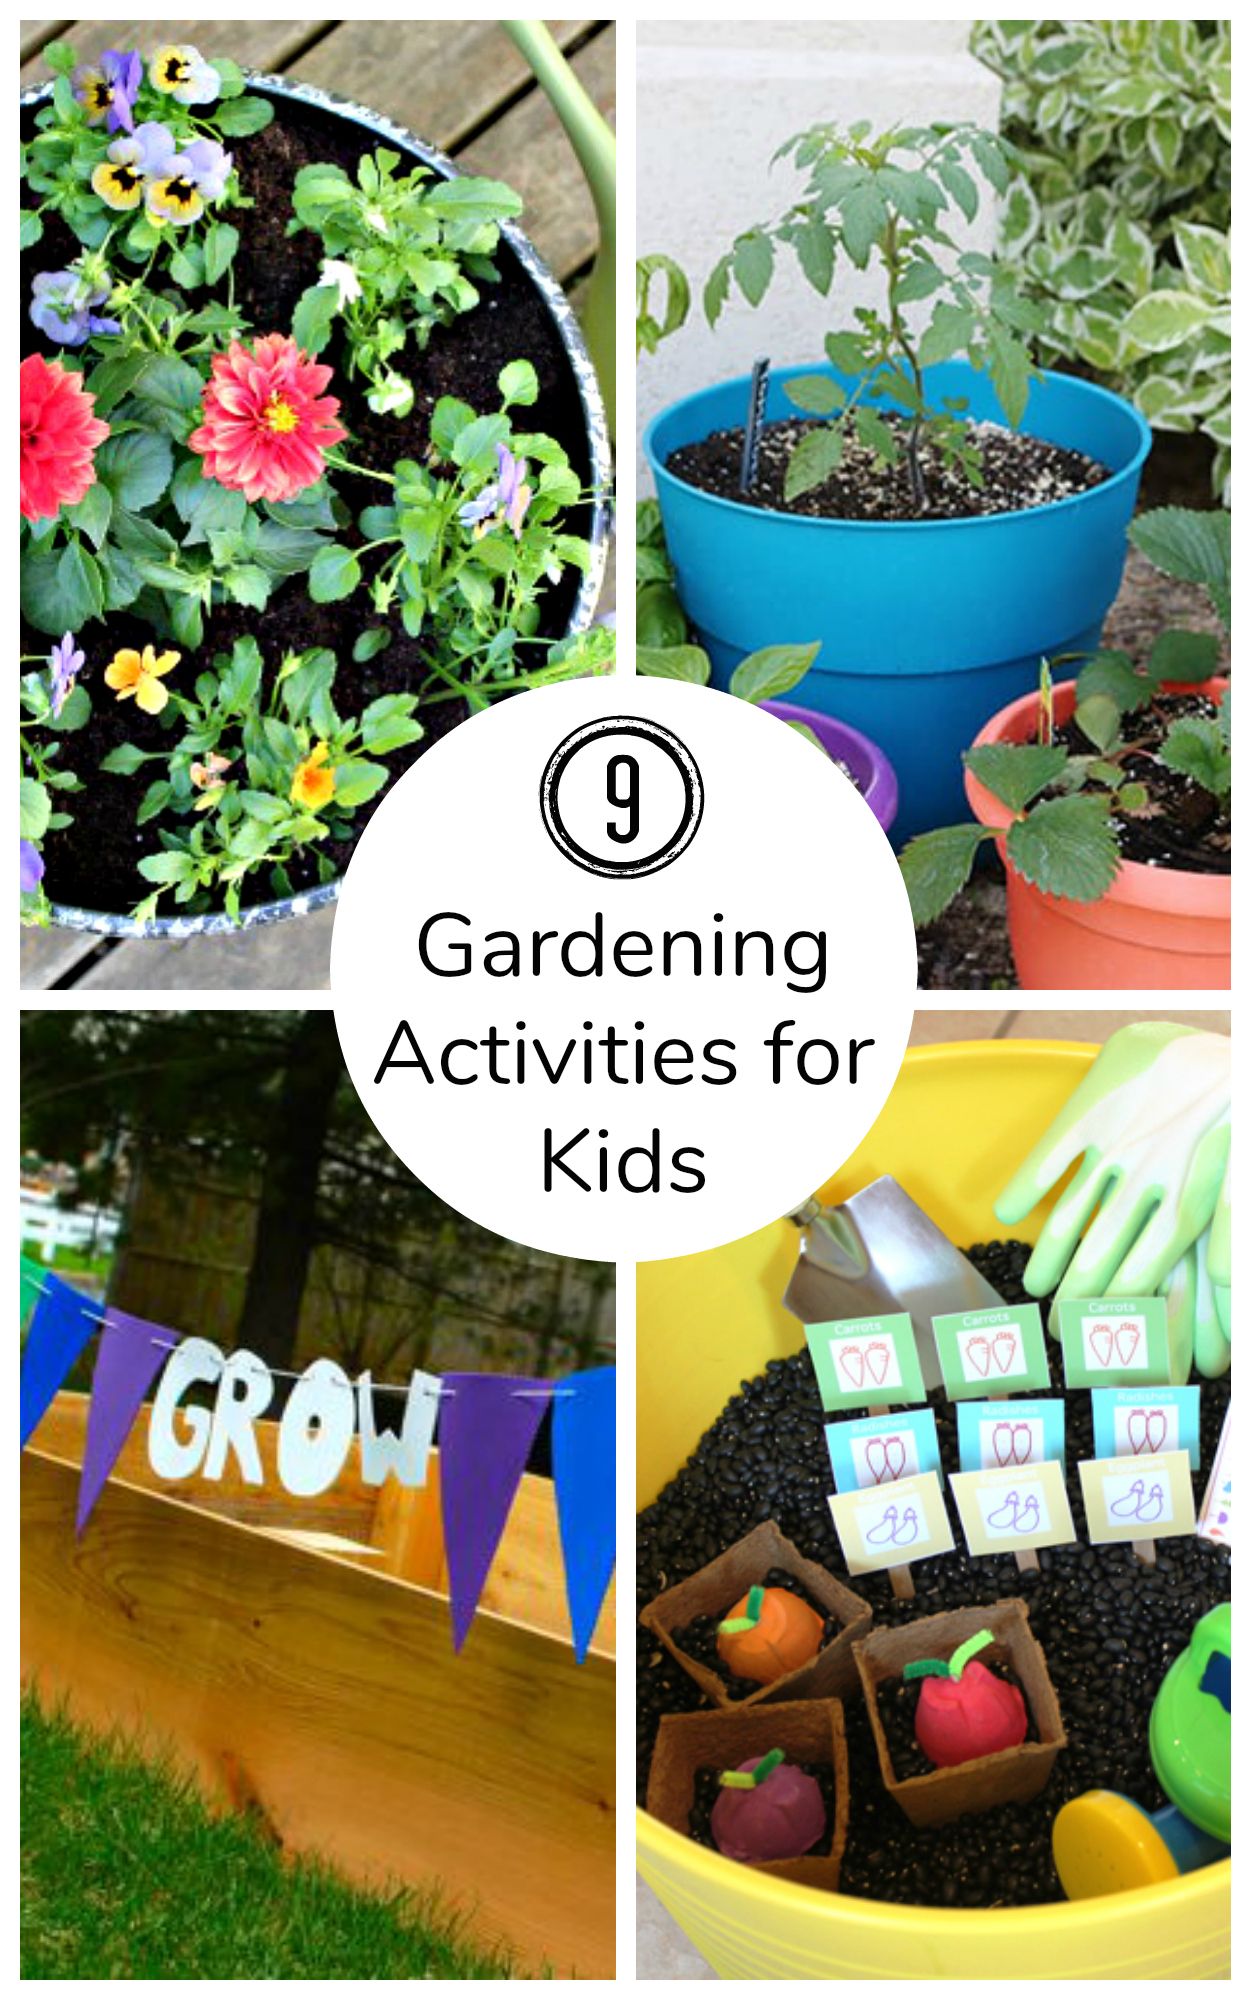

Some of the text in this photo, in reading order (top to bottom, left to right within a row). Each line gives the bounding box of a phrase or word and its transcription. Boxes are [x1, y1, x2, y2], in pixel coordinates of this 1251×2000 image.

[1088, 1302, 1136, 1314] Carrots
[833, 1319, 883, 1336] Carrots
[962, 1312, 1010, 1328] Carrots
[1116, 1391, 1174, 1403] Radishes
[148, 1336, 443, 1496] GROW
